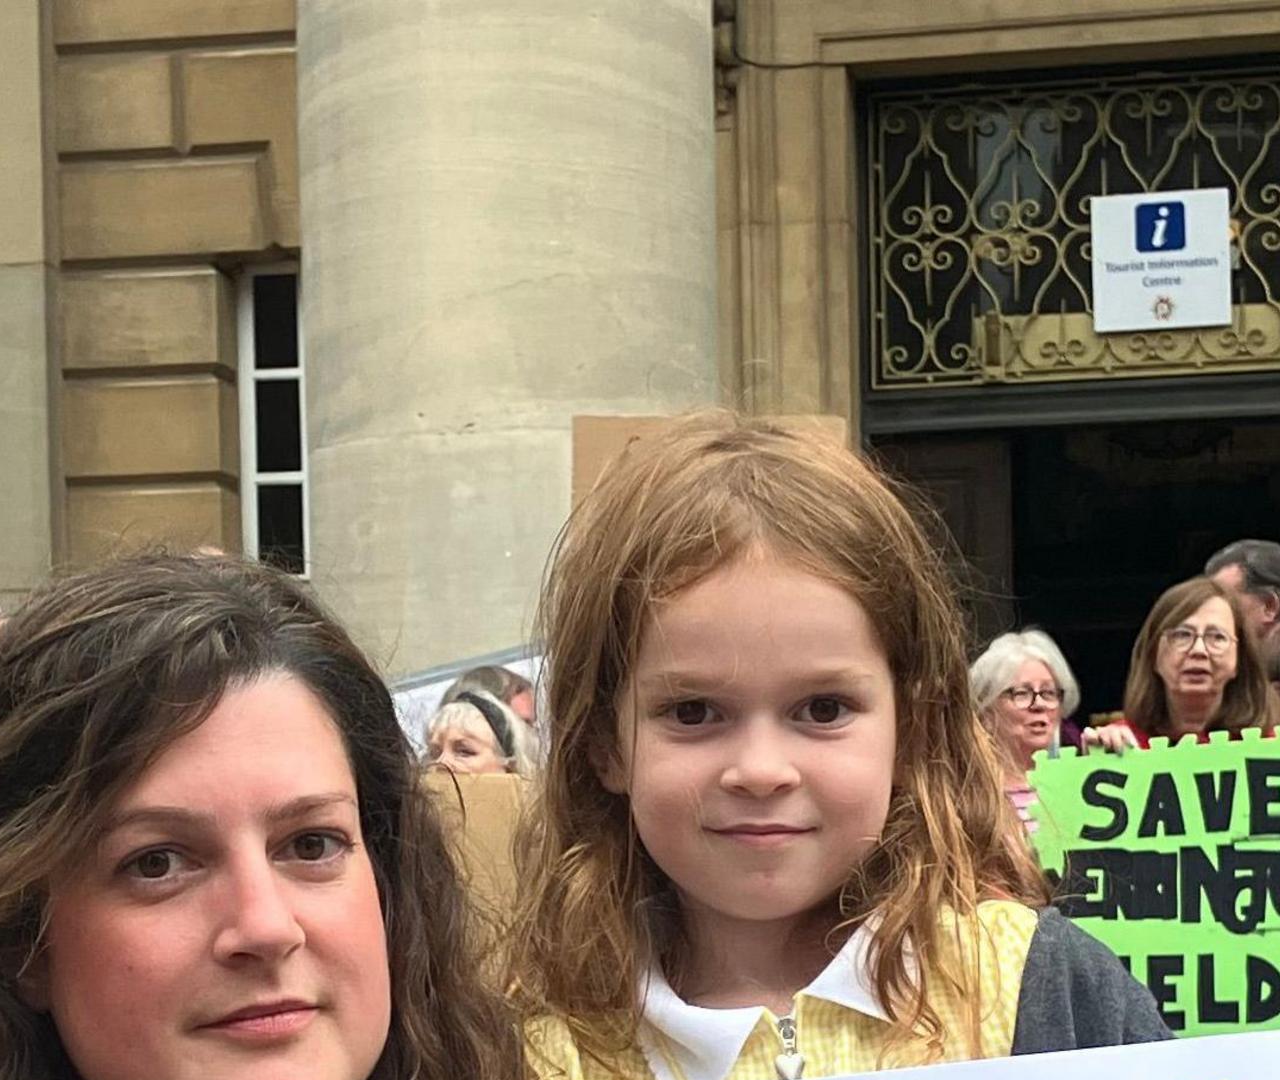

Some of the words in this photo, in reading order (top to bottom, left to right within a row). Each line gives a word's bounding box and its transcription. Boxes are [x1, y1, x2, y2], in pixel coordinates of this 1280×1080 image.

[1105, 261, 1145, 272] Tourist
[1147, 257, 1219, 270] Information
[1142, 277, 1182, 288] Centre
